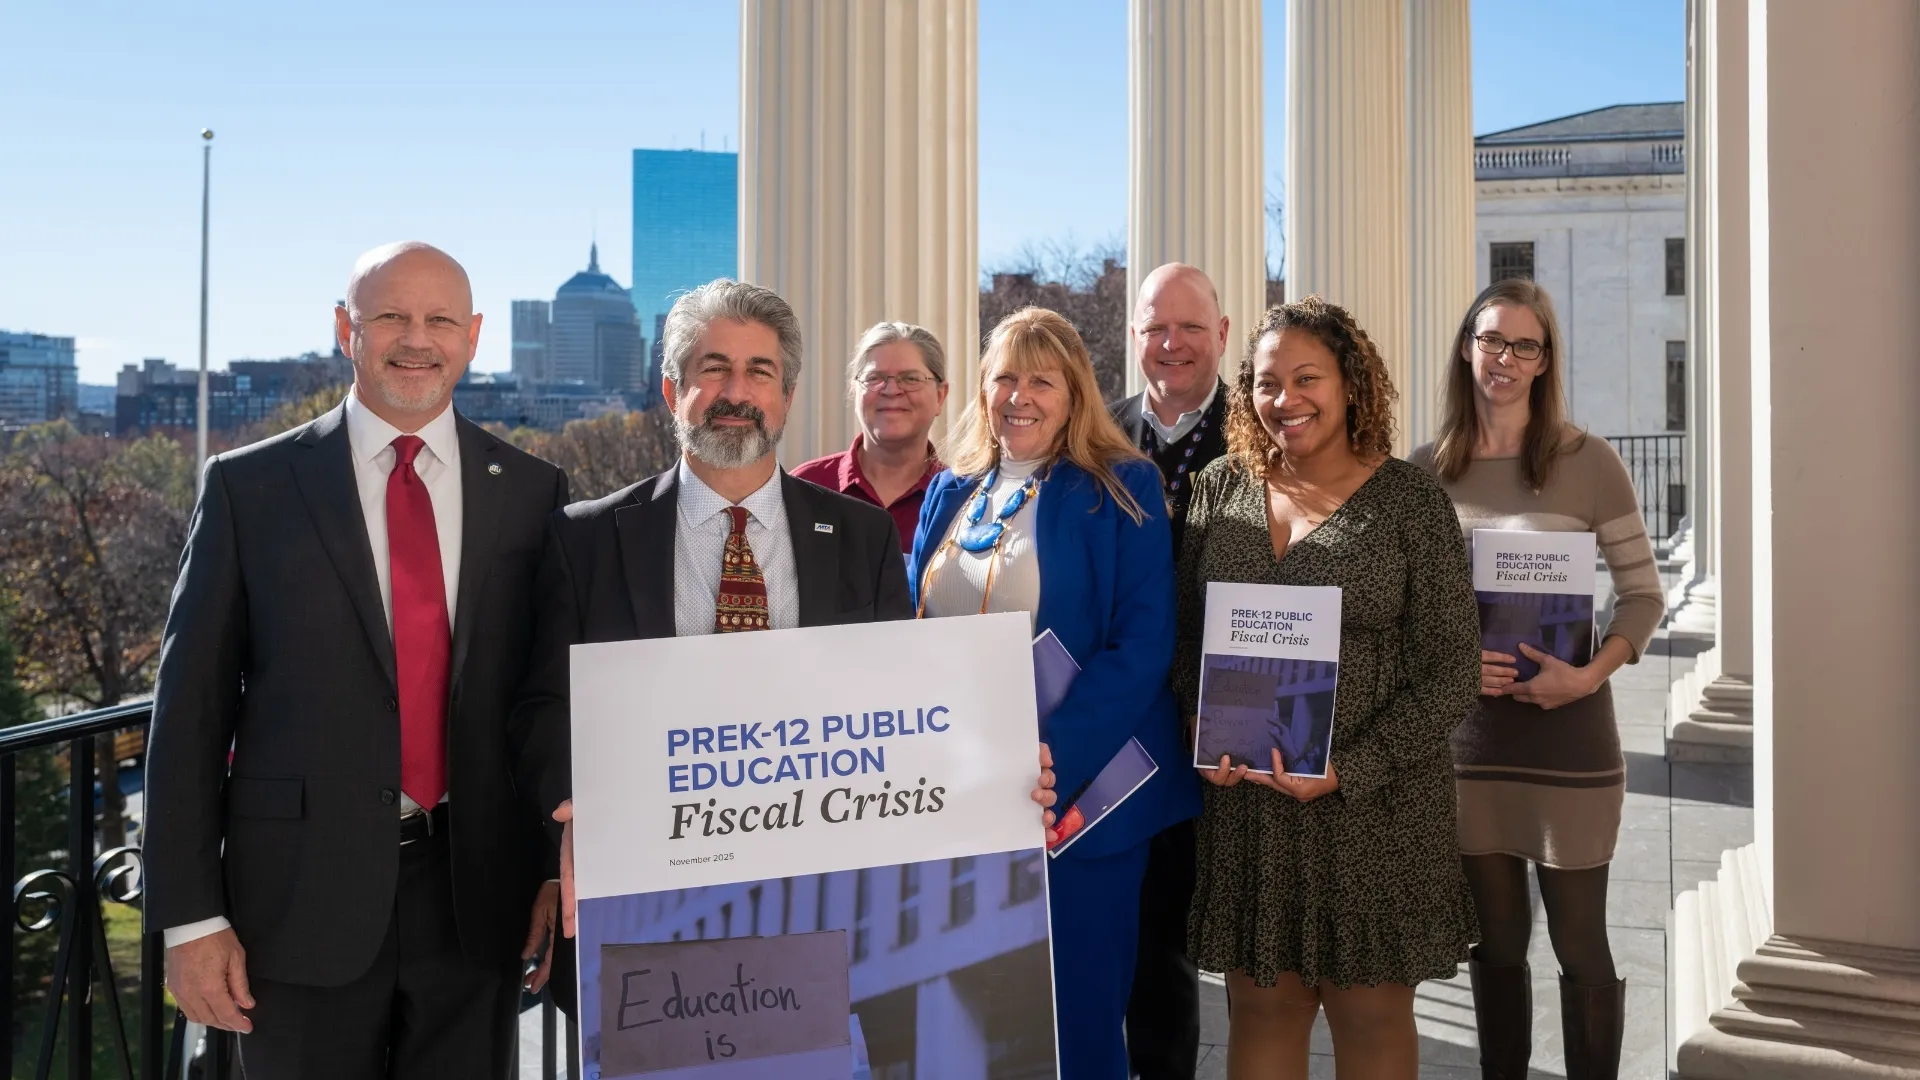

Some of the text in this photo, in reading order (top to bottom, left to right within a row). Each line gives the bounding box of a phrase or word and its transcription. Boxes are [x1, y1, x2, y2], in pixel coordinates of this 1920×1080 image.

[1496, 552, 1570, 562] PREK-12 PUBLIC
[1496, 561, 1552, 570] EDUCATION
[1495, 570, 1568, 582] Fiscal Crisis
[1231, 609, 1313, 622] PREK-12 PUBLIC
[1231, 619, 1293, 631] EDUCATION
[1230, 630, 1310, 646] Fiscal Crisis
[668, 706, 950, 757] PREK-12 PUBLIC
[668, 746, 885, 793] EDUCATION
[668, 777, 946, 840] Fiscal Crisis
[669, 852, 735, 867] November 2025
[617, 962, 801, 1031] Education
[704, 1030, 737, 1060] is
